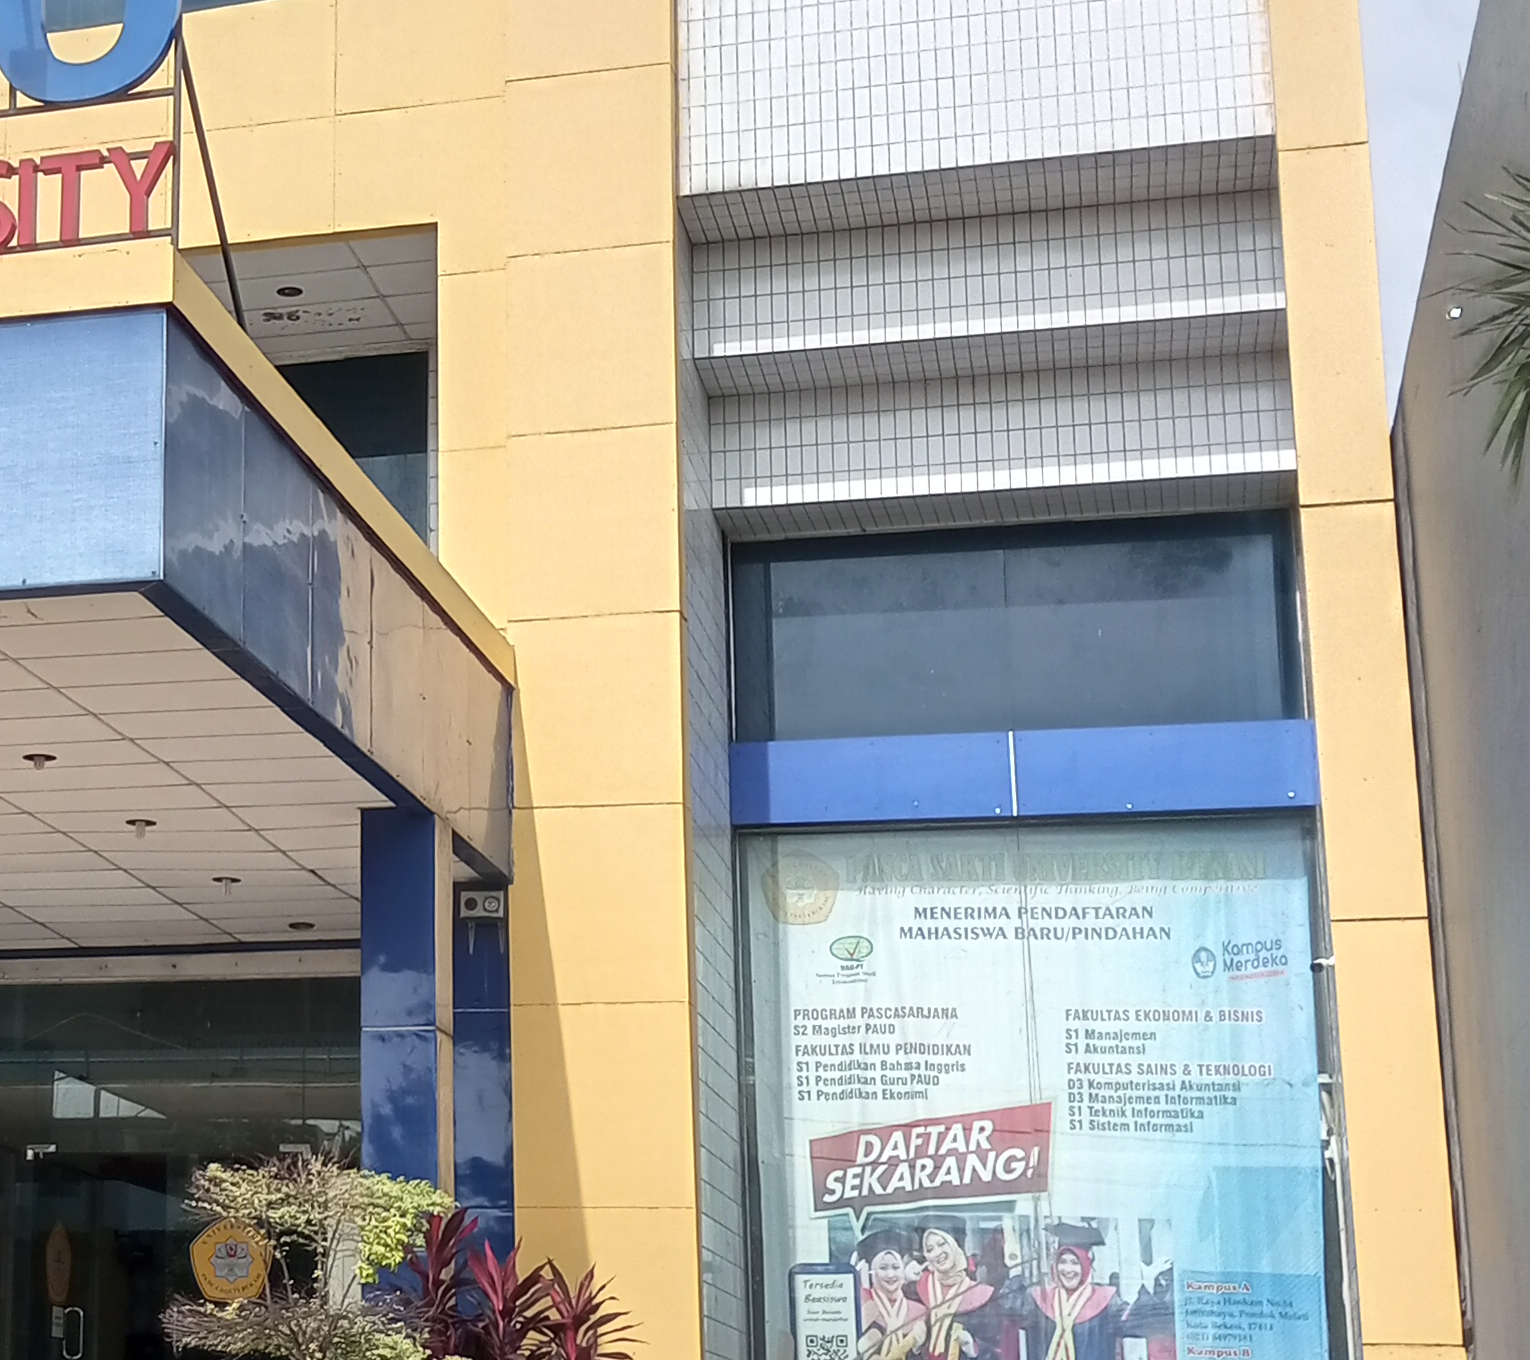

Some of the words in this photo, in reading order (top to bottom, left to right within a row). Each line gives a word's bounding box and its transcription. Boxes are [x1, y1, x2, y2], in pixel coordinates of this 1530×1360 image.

[914, 906, 1011, 920] MENERIMA
[1018, 906, 1154, 920] PENDAFTARAN
[899, 926, 1008, 940] MAHASISWA
[1014, 926, 1171, 941] BARU/PINDAHAN
[1222, 939, 1282, 956] Kampus
[1223, 953, 1288, 973] Merdeka
[793, 1007, 856, 1021] PROGRAM
[861, 1006, 959, 1020] PASCASARJANA
[1065, 1008, 1130, 1022] FAKULTAS
[1135, 1009, 1199, 1022] EKONOMI
[1203, 1010, 1214, 1022] &
[1218, 1010, 1264, 1023] BISNIS
[793, 1024, 808, 1036] S2
[812, 1024, 861, 1038] Magister
[865, 1023, 896, 1035] PAUD
[1065, 1028, 1079, 1040] S1
[1084, 1028, 1157, 1043] Manajemen
[795, 1043, 855, 1057] FAKULTAS
[859, 1042, 890, 1055] ILMU
[895, 1042, 972, 1056] PENDIDIKAN
[1065, 1043, 1079, 1054] S1
[1084, 1043, 1146, 1055] Akuntansi
[796, 1061, 810, 1072] S1
[815, 1060, 876, 1072] Pendidikan
[880, 1060, 920, 1072] Bahasa
[924, 1060, 966, 1074] Inggris
[1067, 1062, 1132, 1076] FAKULTAS
[1137, 1063, 1177, 1076] SAINS
[1182, 1064, 1192, 1076] &
[1197, 1063, 1273, 1077] TEKNOLOGI
[796, 1075, 810, 1087] S1
[815, 1074, 876, 1086] Pendidikan
[880, 1075, 908, 1086] Guru
[910, 1074, 940, 1086] PAUD
[1067, 1078, 1084, 1090] D3
[1087, 1078, 1176, 1094] Komputerisasi
[1180, 1080, 1241, 1092] Akuntansi
[798, 1090, 812, 1101] S1
[816, 1088, 878, 1101] Pendidikan
[1068, 1092, 1084, 1104] D3
[1088, 1092, 1160, 1107] Manajemen
[1164, 1093, 1237, 1106] Informatika
[1069, 1106, 1082, 1118] S1
[1087, 1106, 1127, 1119] Teknik
[1131, 1107, 1204, 1120] Informatika
[1069, 1119, 1083, 1131] S1
[1088, 1119, 1130, 1132] Sistem
[1134, 1120, 1194, 1133] Informasi
[856, 1120, 994, 1165] DAFTAR
[822, 1146, 1041, 1203] SEKARANG!
[1186, 1281, 1238, 1294] Kampus
[1241, 1283, 1251, 1292] A
[1187, 1346, 1239, 1358] Kampus
[1242, 1348, 1251, 1357] B
